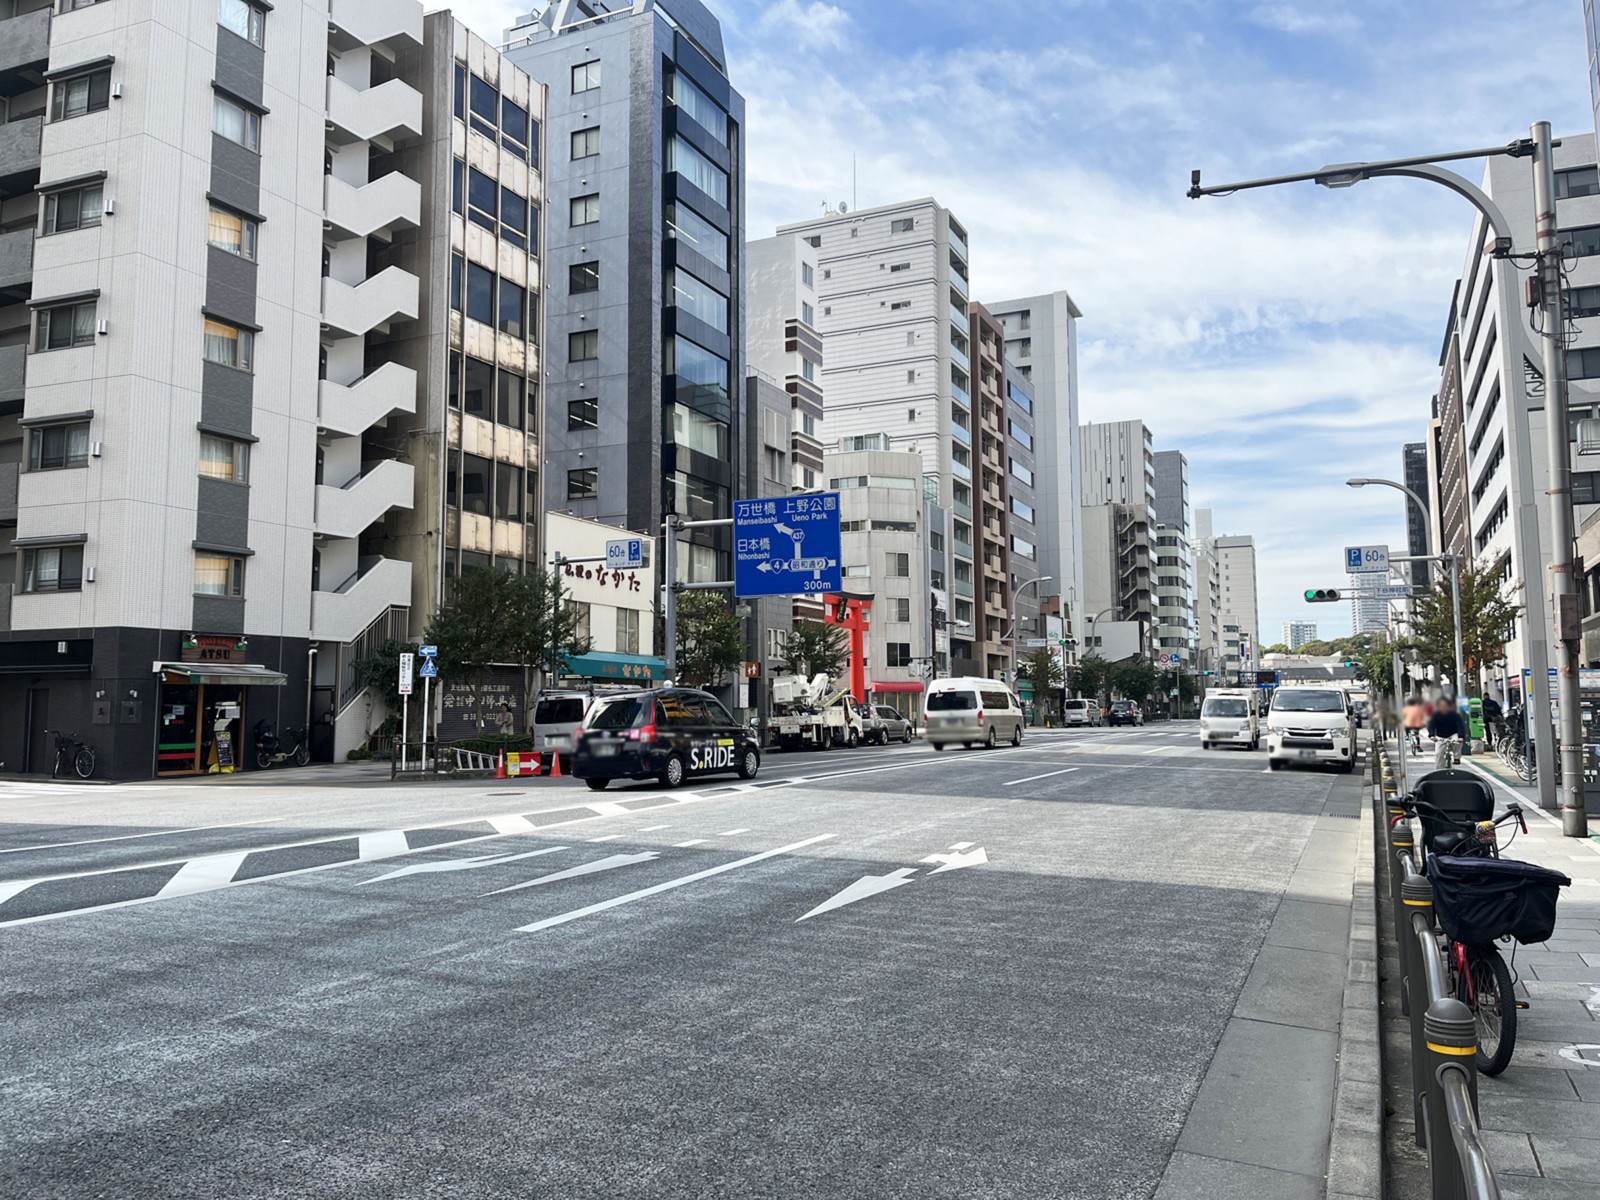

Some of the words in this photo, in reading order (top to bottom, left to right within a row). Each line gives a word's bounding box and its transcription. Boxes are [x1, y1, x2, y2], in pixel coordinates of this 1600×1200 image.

[738, 502, 776, 517] 万世橋
[783, 497, 836, 514] 上野公園
[737, 516, 777, 526] Manseibashi
[792, 514, 810, 522] Ueno
[811, 512, 828, 520] Park
[631, 542, 638, 554] P
[737, 538, 771, 552] 日本橋
[738, 552, 770, 560] Nihonbashi
[1351, 550, 1358, 560] P
[773, 561, 780, 569] 4
[792, 559, 824, 569] 昭和通り
[804, 581, 831, 590] 300m
[200, 649, 230, 660] ATSU
[691, 746, 735, 770] S.RIDE
